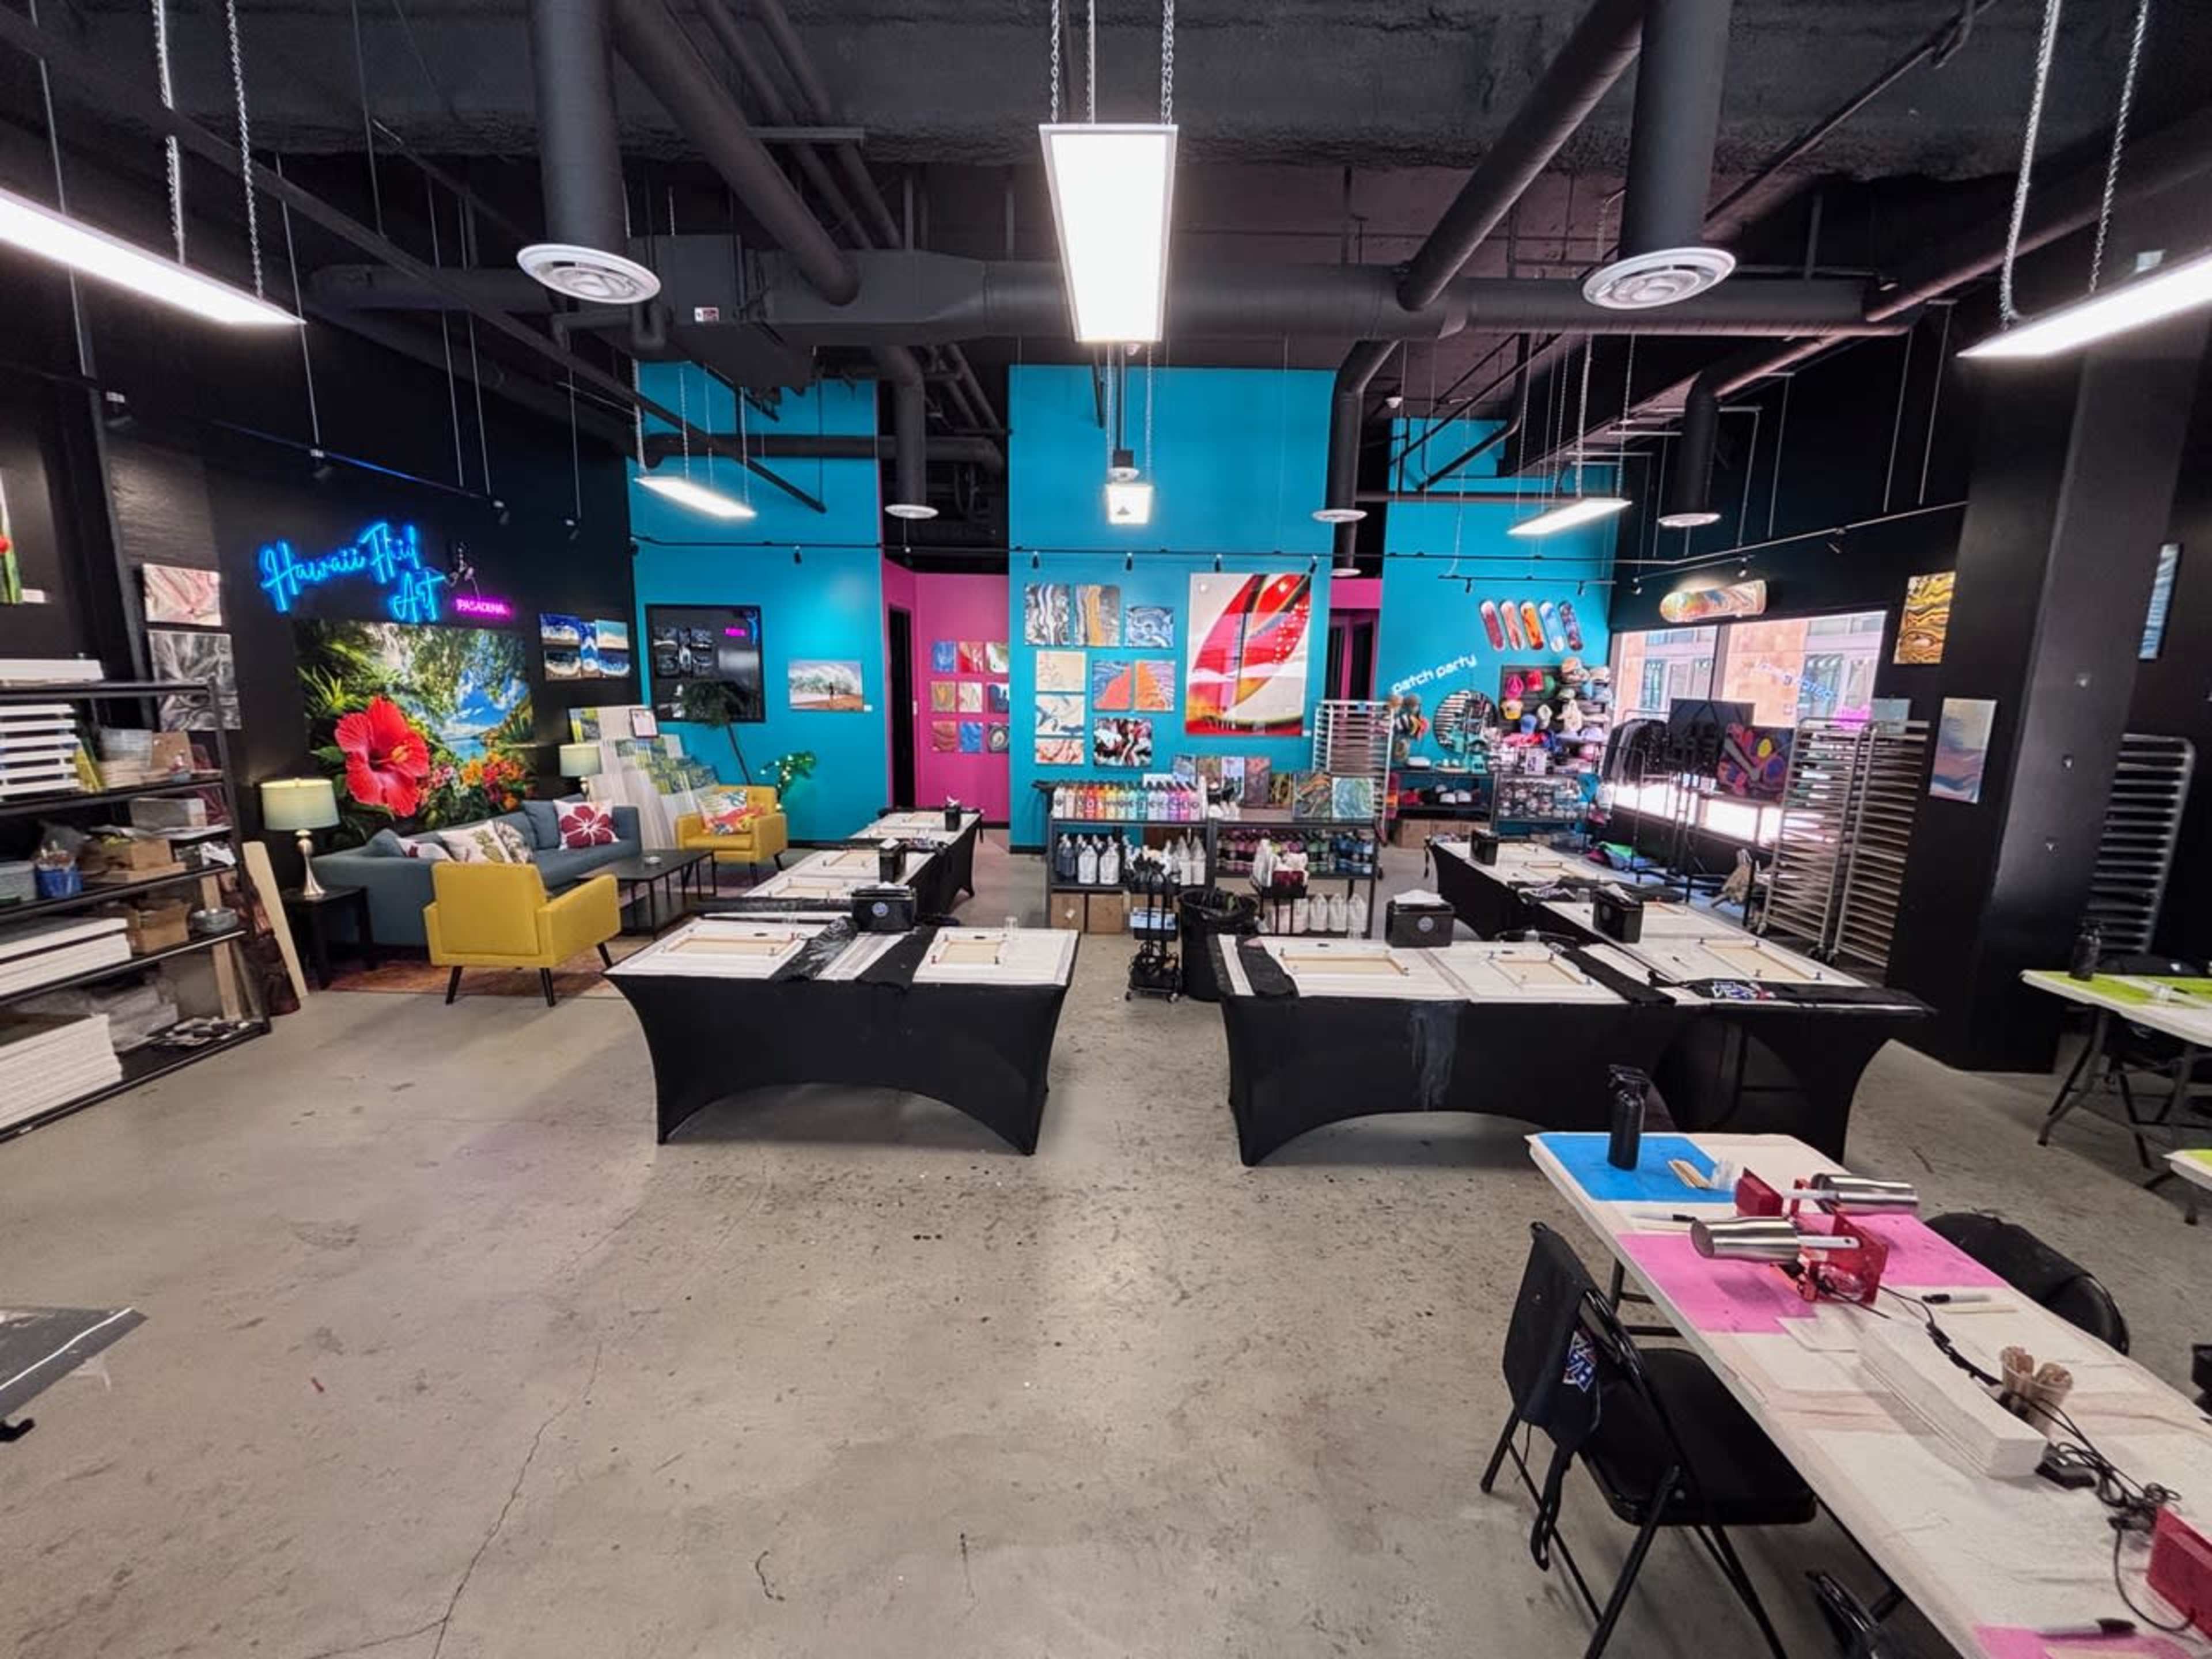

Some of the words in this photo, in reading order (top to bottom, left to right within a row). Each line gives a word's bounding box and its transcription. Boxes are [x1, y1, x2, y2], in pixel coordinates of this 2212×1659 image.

[260, 540, 368, 612] Hawaii
[392, 569, 446, 624] Art
[1391, 669, 1434, 695] patch
[1435, 653, 1477, 679] party
